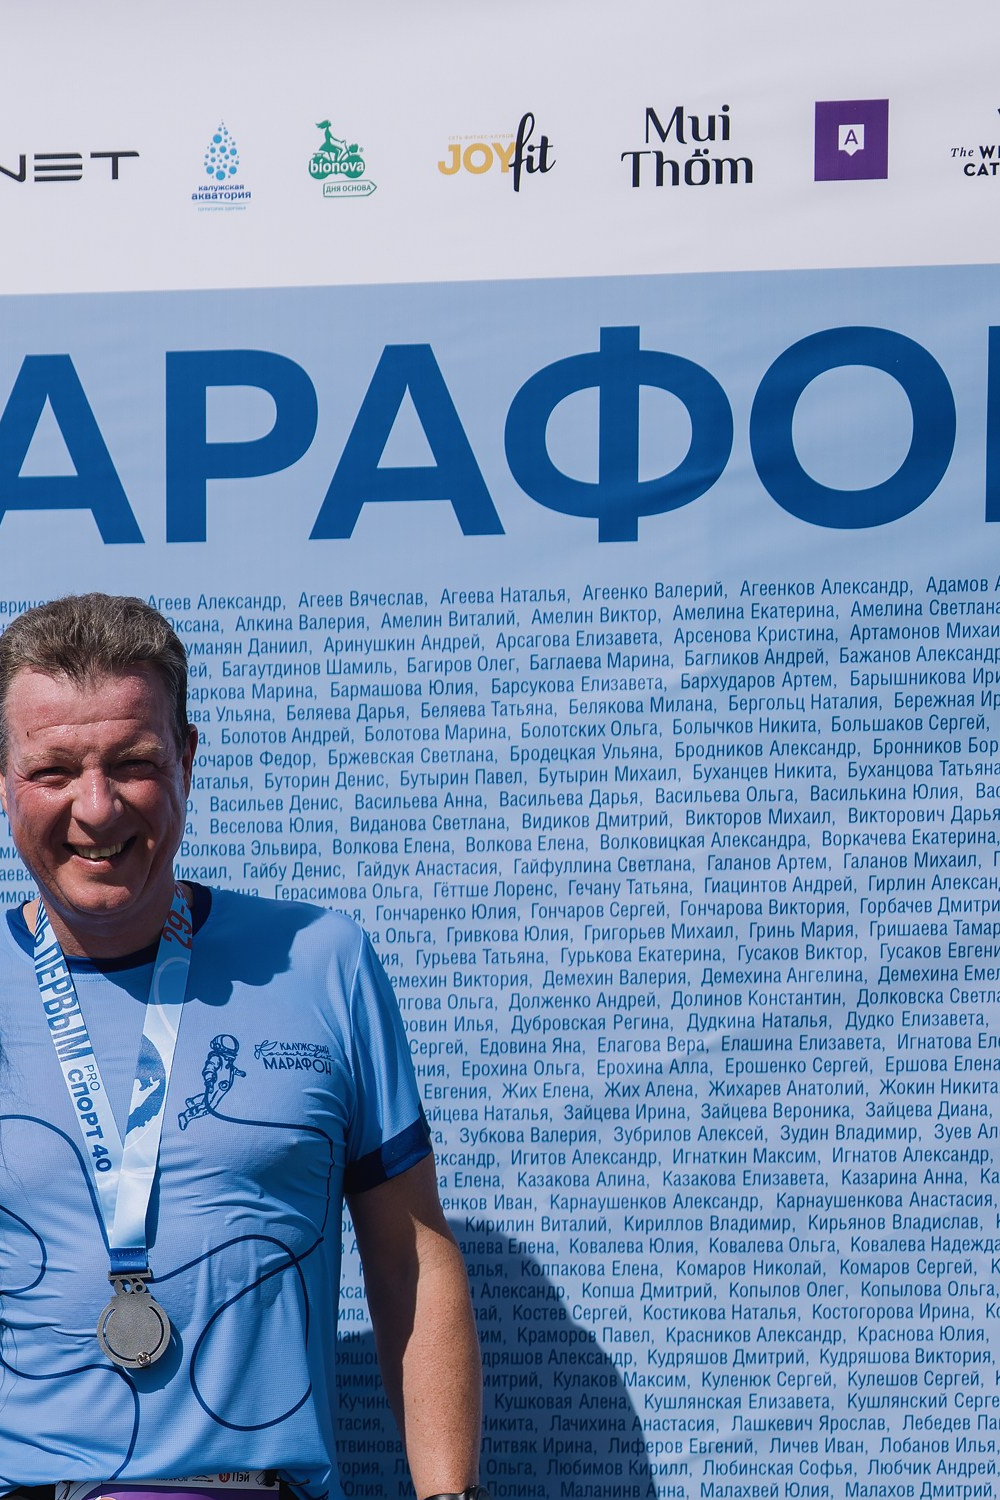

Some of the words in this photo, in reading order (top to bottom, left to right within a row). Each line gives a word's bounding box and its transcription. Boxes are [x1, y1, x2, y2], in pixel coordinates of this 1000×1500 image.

[646, 104, 730, 144] Mui
[844, 129, 858, 145] A
[951, 147, 974, 157] The
[979, 145, 1000, 159] W
[311, 158, 364, 174] bionova
[191, 191, 252, 201] акватория
[198, 184, 245, 192] калужская
[325, 184, 341, 193] ДНЯ
[342, 183, 372, 192] ОСНОВА
[299, 592, 342, 607] Агеев
[350, 591, 427, 606] Вячеслав,
[441, 589, 493, 604] Агеева
[501, 587, 569, 603] Наталья,
[583, 585, 647, 600] Агеенко
[655, 581, 727, 600] Валерий,
[740, 580, 814, 596] Агеенков
[822, 579, 912, 597] Александр,
[926, 576, 988, 597] Адамов
[532, 903, 603, 921] Гончаров
[610, 902, 669, 920] Сергей,
[680, 900, 763, 917] Гончарова
[769, 899, 848, 918] Виктория,
[35, 940, 94, 1063] ПЕРВЫМ
[280, 1042, 329, 1055] КАЛУЖСКИЙ
[263, 1057, 331, 1075] МАРАФОН
[83, 1064, 100, 1091] PRO
[503, 1083, 536, 1098] Жих
[544, 1083, 593, 1099] Елена,
[605, 1082, 639, 1097] Жих
[645, 1082, 697, 1098] Алена,
[709, 1081, 780, 1099] Жихарев
[786, 1081, 870, 1097] Анатолий,
[880, 1079, 934, 1094] Жокин
[67, 1069, 104, 1138] СПОРТ
[92, 1140, 112, 1173] 40
[732, 1416, 812, 1431] Лашкевич
[819, 1416, 891, 1432] Ярослав,
[703, 1460, 792, 1475] Любинская
[799, 1460, 857, 1478] Софья,
[868, 1460, 931, 1474] Любчик
